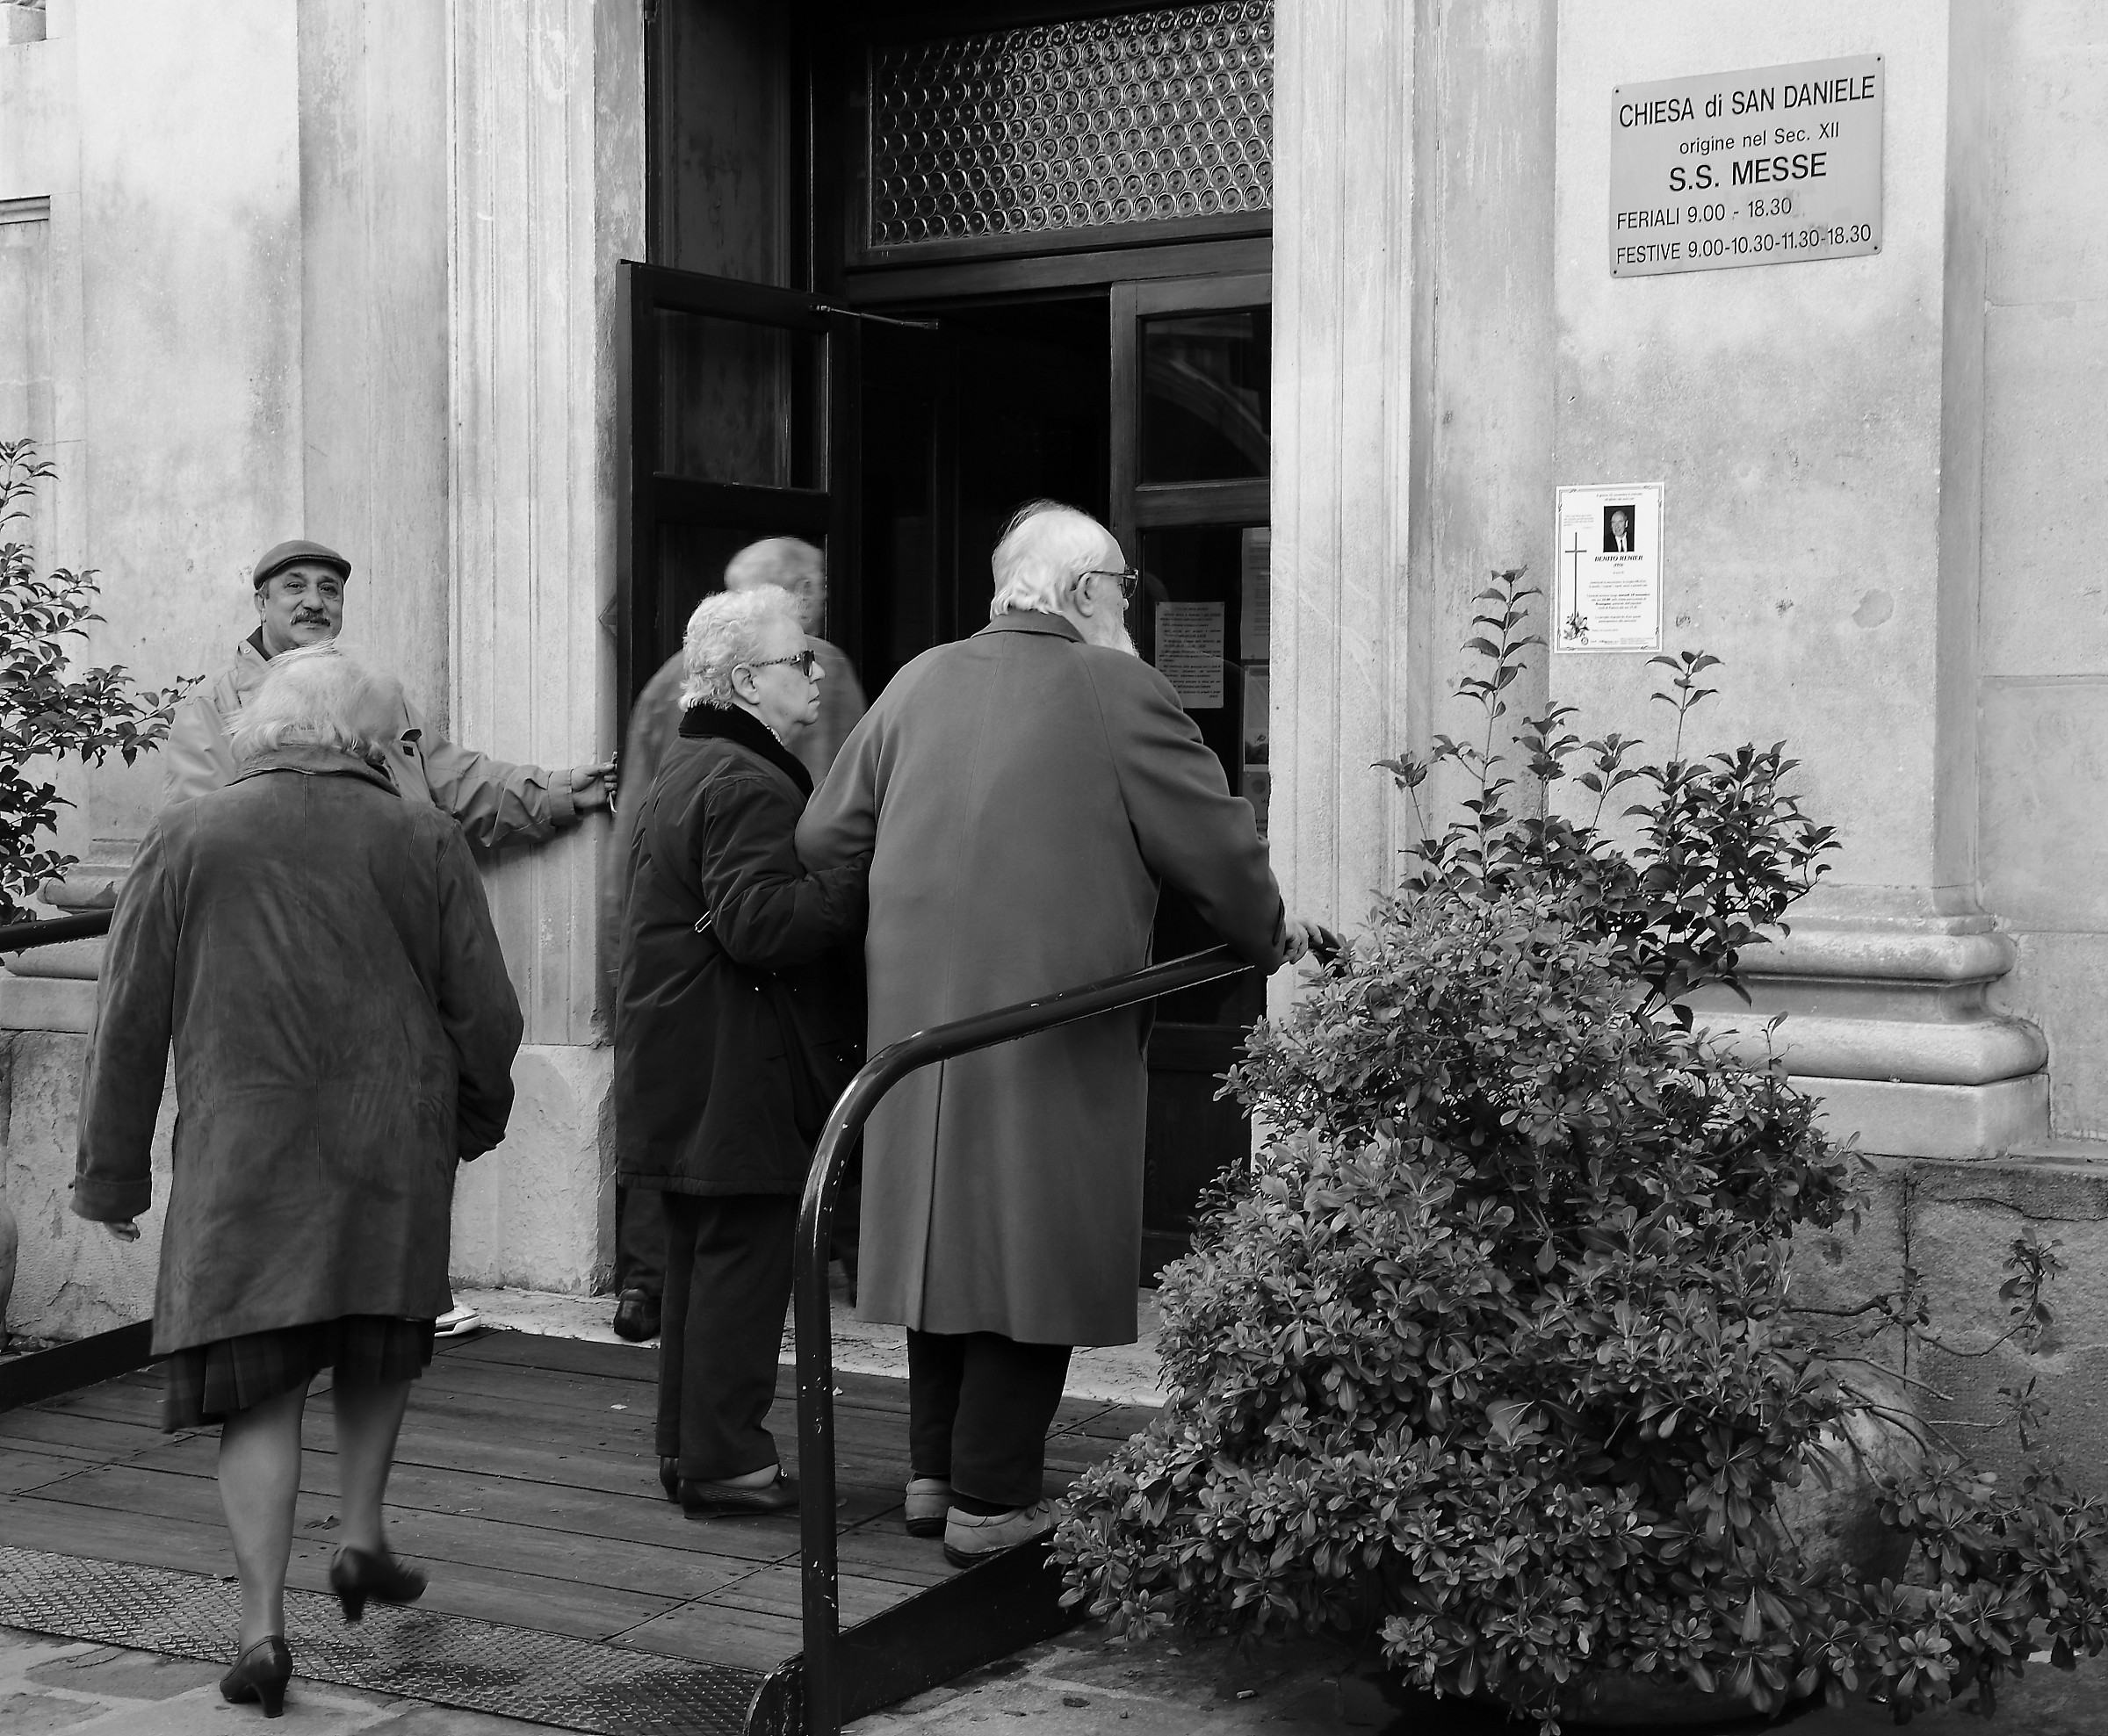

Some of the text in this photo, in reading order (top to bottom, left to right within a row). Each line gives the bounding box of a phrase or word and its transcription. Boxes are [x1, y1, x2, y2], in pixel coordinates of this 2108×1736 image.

[1619, 75, 1876, 128] CHIESA di SAN DANIELE
[1679, 121, 1839, 156] origine nel Sec. XII
[1669, 151, 1827, 192] S.S. MESSE
[1617, 207, 1679, 230] FERIALI
[1687, 203, 1726, 224] 9.00
[1748, 197, 1792, 218] 18.30
[1617, 241, 1681, 265] FESTIVE
